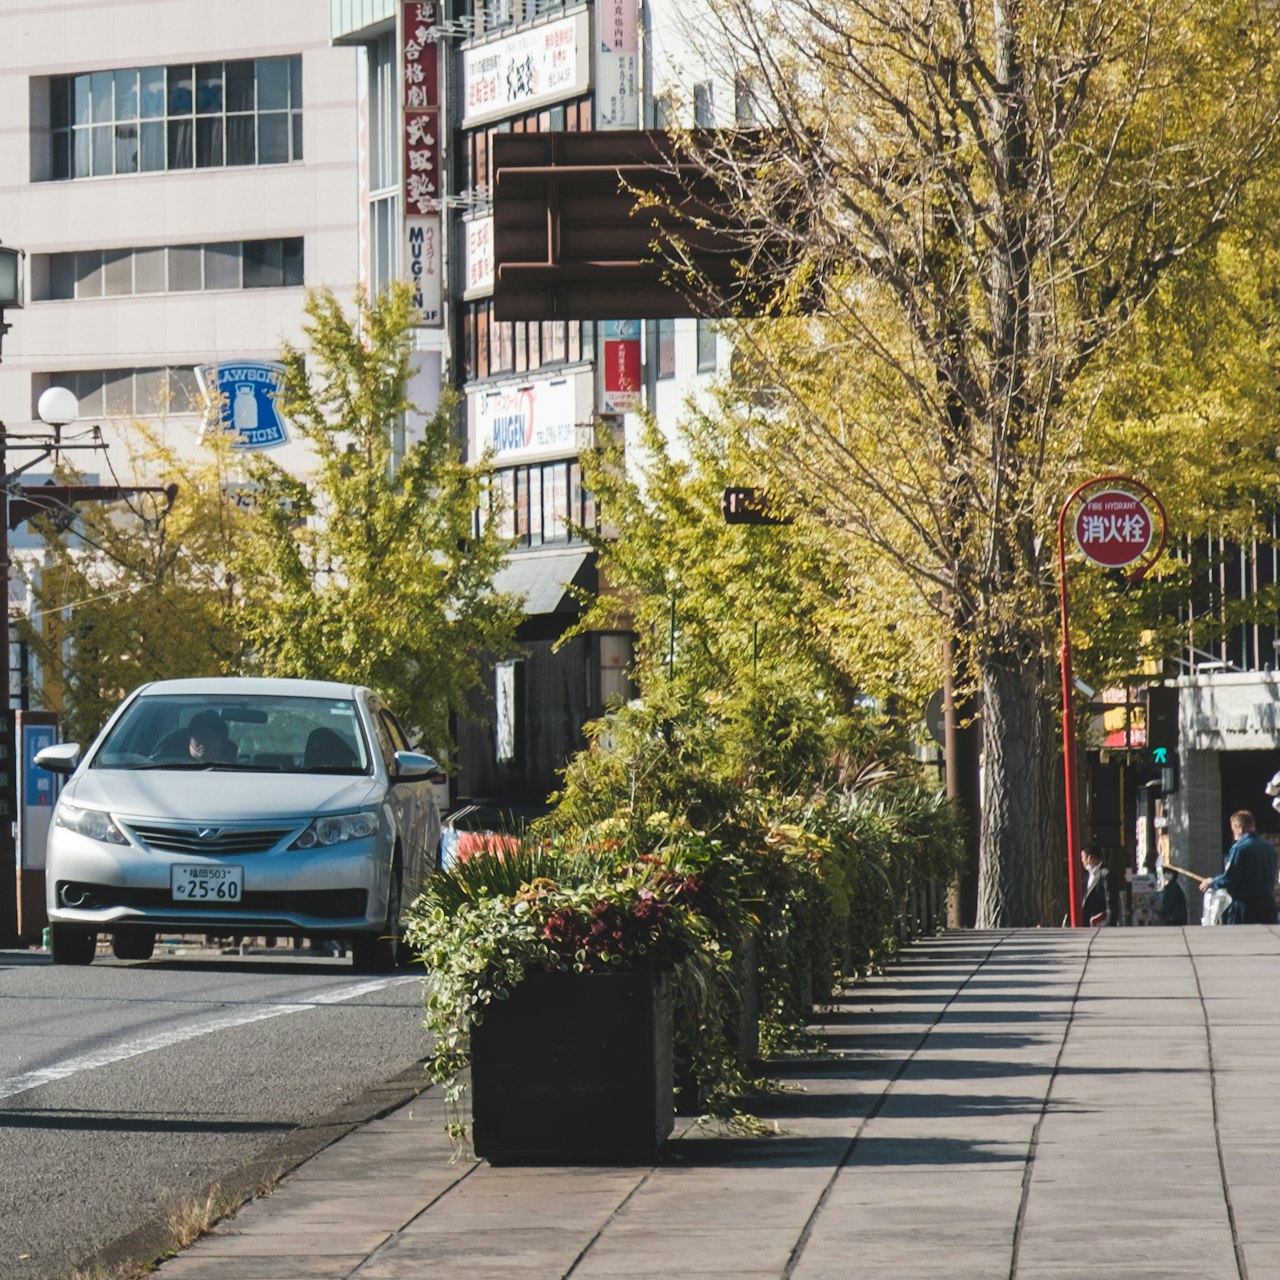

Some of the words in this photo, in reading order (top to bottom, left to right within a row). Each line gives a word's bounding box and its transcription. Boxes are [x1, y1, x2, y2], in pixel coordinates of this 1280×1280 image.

[423, 310, 437, 320] 3F
[493, 414, 525, 452] MUGEN
[1088, 502, 1103, 510] FIRE
[1105, 501, 1137, 510] HYDRANT
[1083, 514, 1145, 543] 消火栓
[188, 880, 237, 899] 25-60
